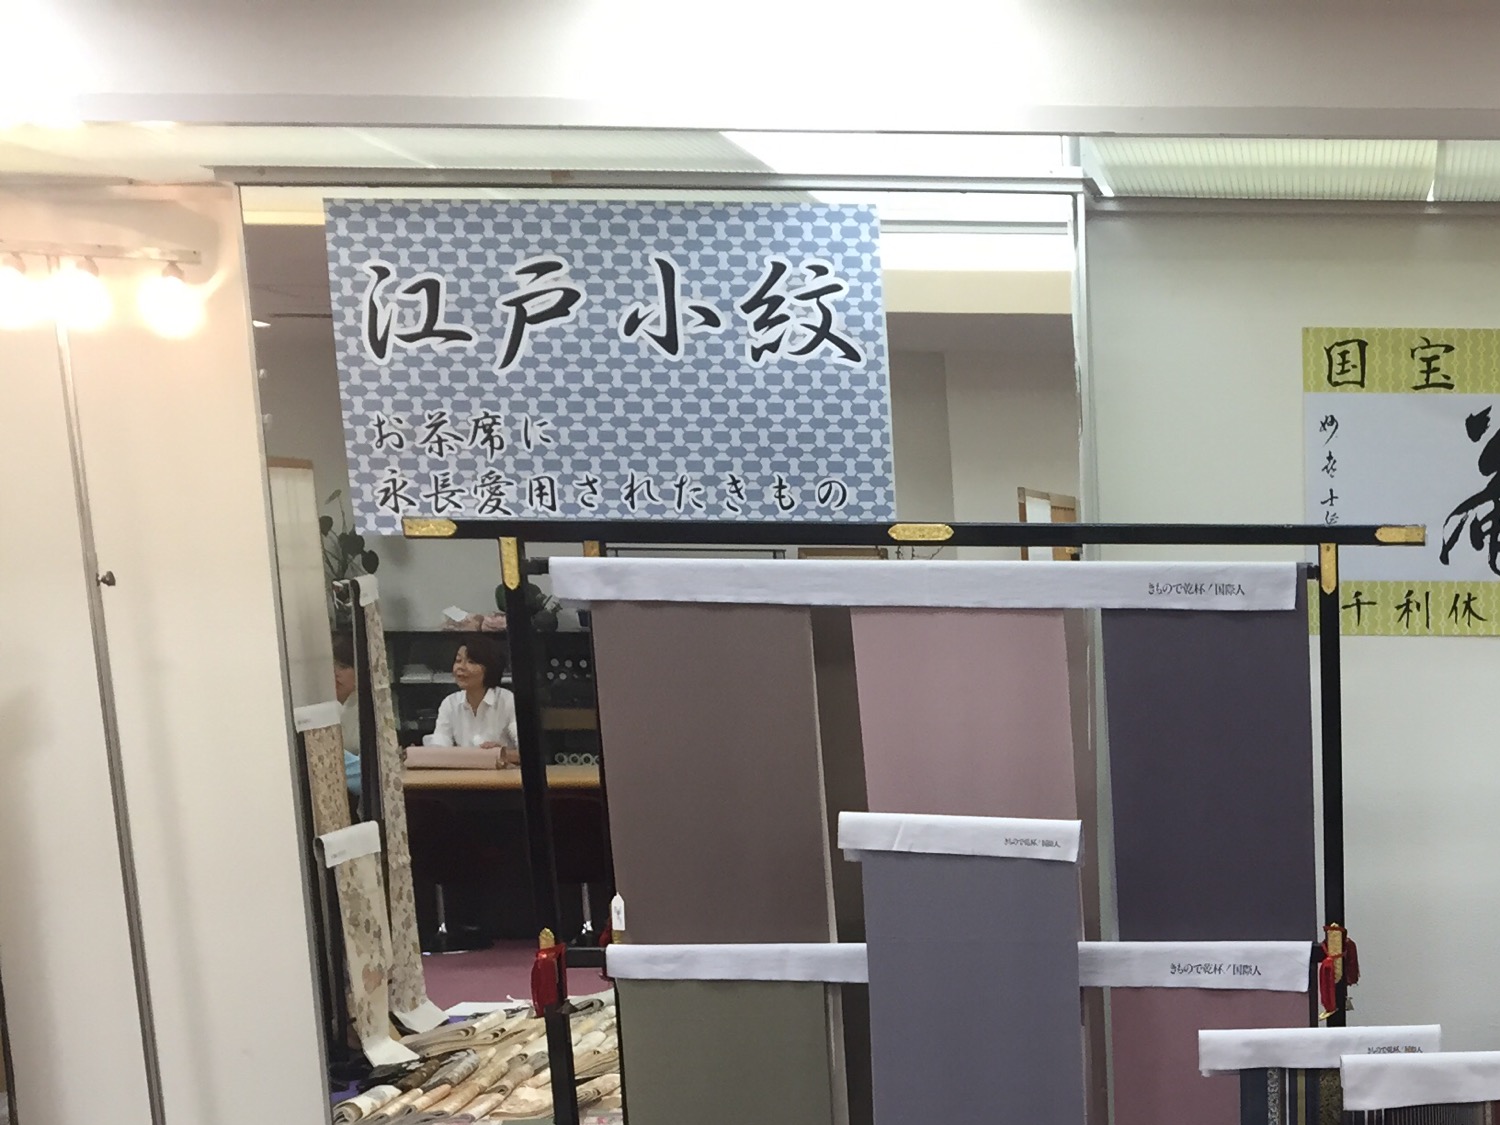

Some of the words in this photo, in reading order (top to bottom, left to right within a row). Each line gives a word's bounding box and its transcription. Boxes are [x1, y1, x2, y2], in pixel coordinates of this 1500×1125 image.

[366, 257, 863, 370] 江戸小紋
[1324, 337, 1457, 391] 国宝
[372, 411, 552, 459] お茶席に
[377, 468, 848, 516] 永長愛用されたきもの
